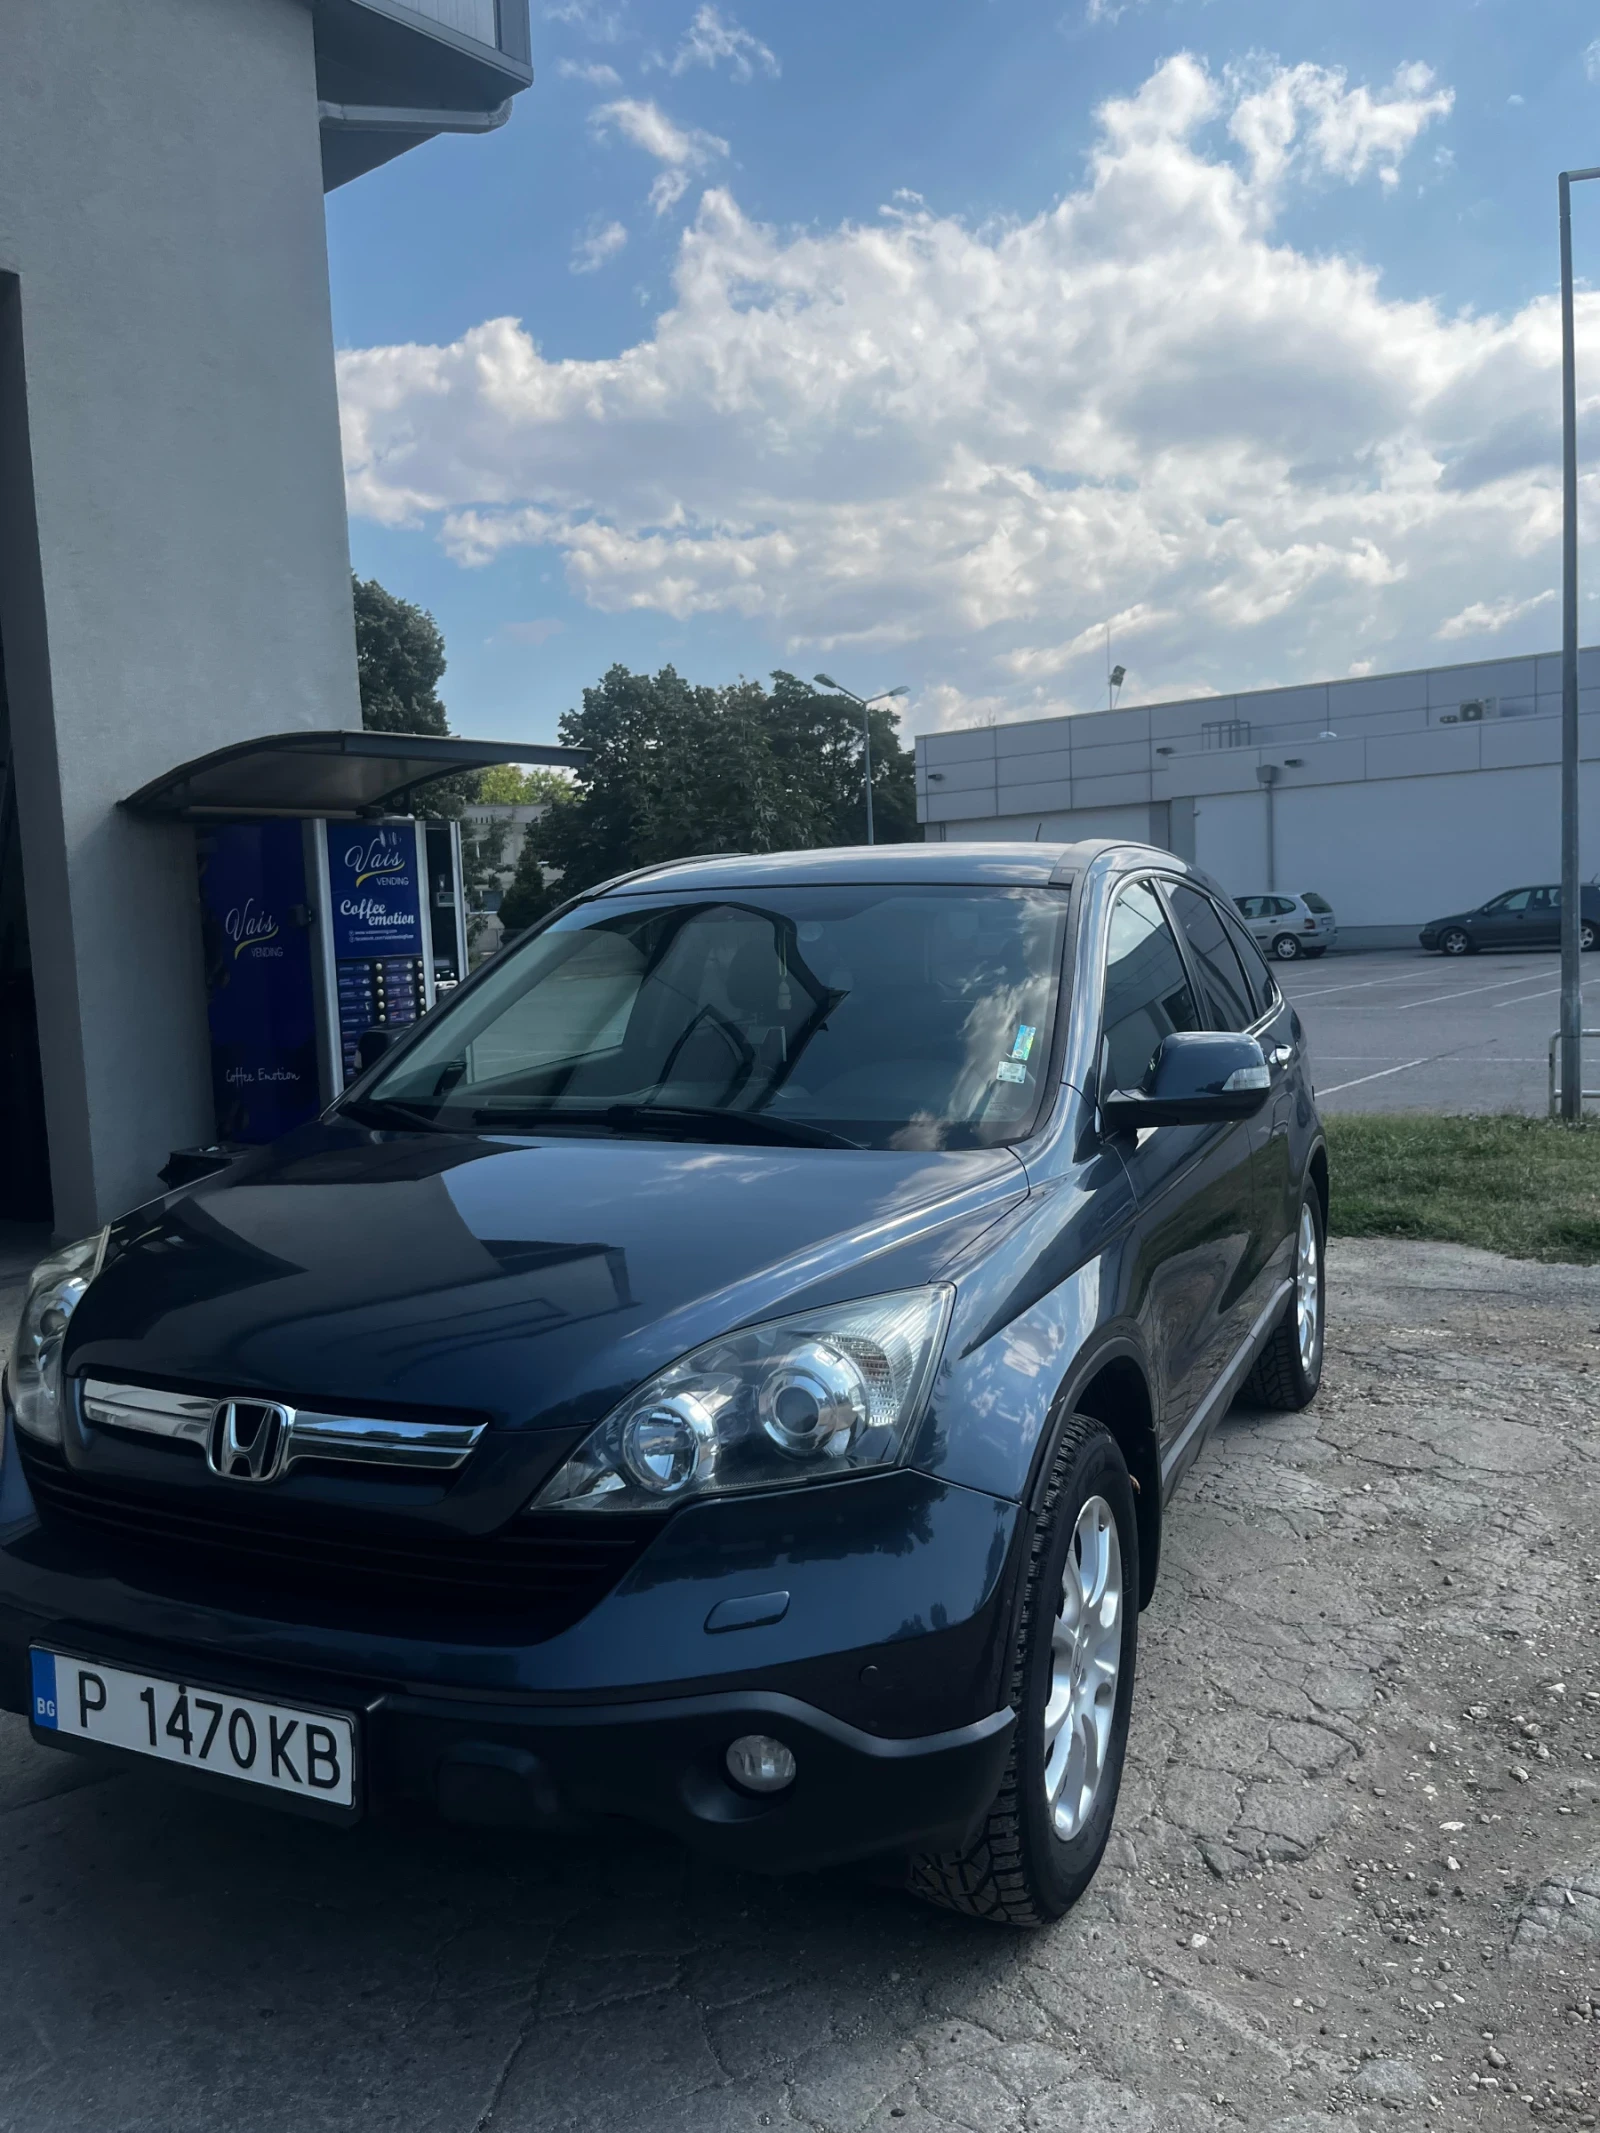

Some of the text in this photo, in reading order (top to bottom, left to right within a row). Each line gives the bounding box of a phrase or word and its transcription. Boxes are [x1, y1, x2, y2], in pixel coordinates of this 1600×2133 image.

[344, 837, 403, 873] Vais
[376, 877, 409, 886] VENDING
[340, 898, 386, 919] Coffee
[368, 911, 415, 926] emotion
[226, 898, 276, 941] Vais
[251, 947, 283, 957] VENDING
[226, 1066, 300, 1087] Coffee Emotion
[37, 1696, 55, 1717] BG
